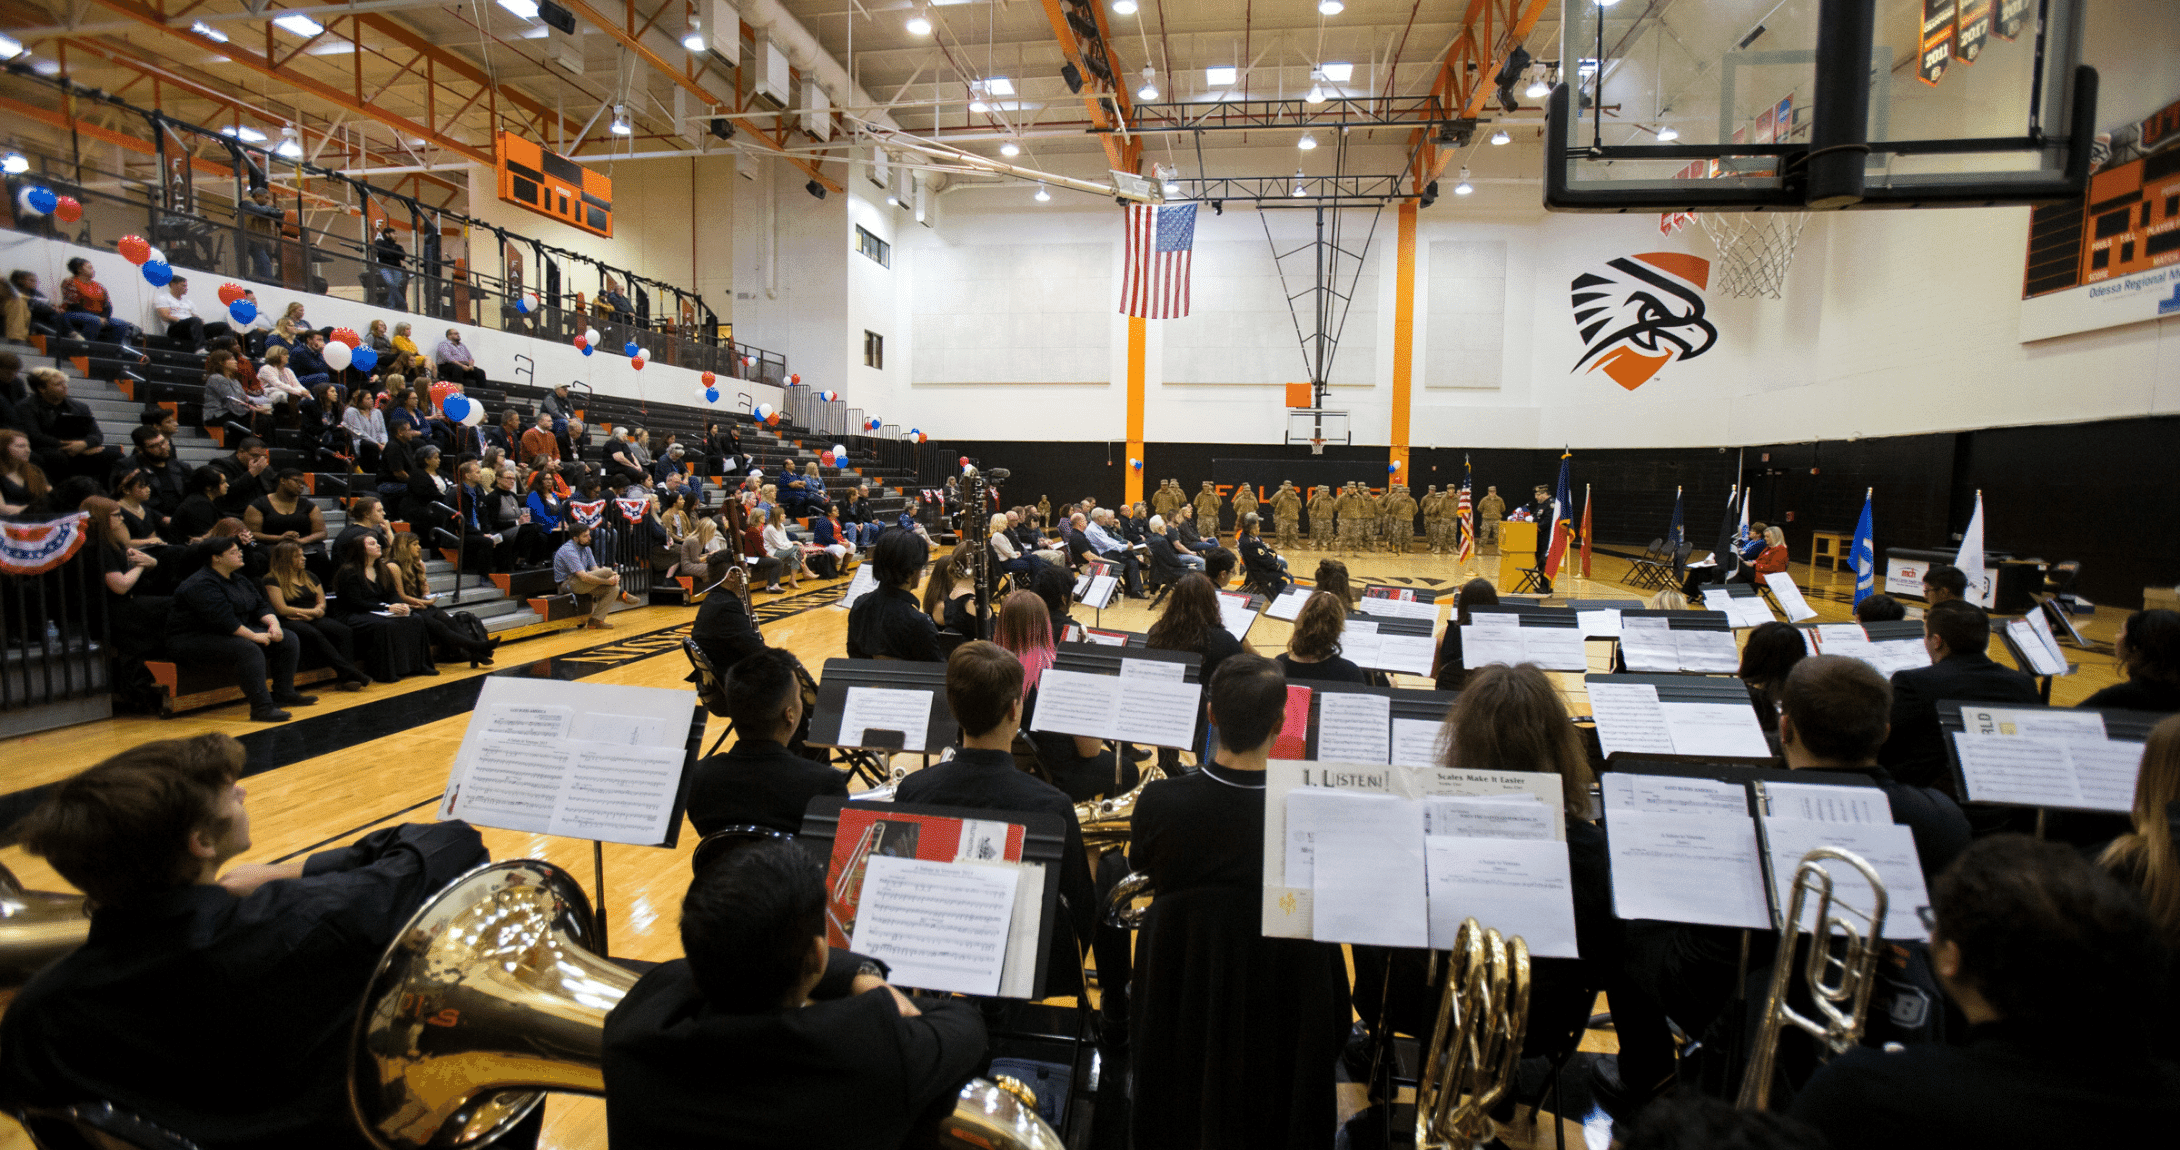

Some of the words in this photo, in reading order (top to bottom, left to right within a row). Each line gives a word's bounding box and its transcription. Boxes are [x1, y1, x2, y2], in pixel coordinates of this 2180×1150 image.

[1960, 18, 1989, 47] 2017
[1925, 43, 1949, 68] 2011
[2089, 283, 2122, 298] Odessa
[2124, 270, 2167, 291] Regional
[1303, 768, 1318, 787] 1.
[1436, 772, 1464, 781] Scales
[1466, 774, 1489, 783] Make
[1499, 776, 1526, 784] Easier
